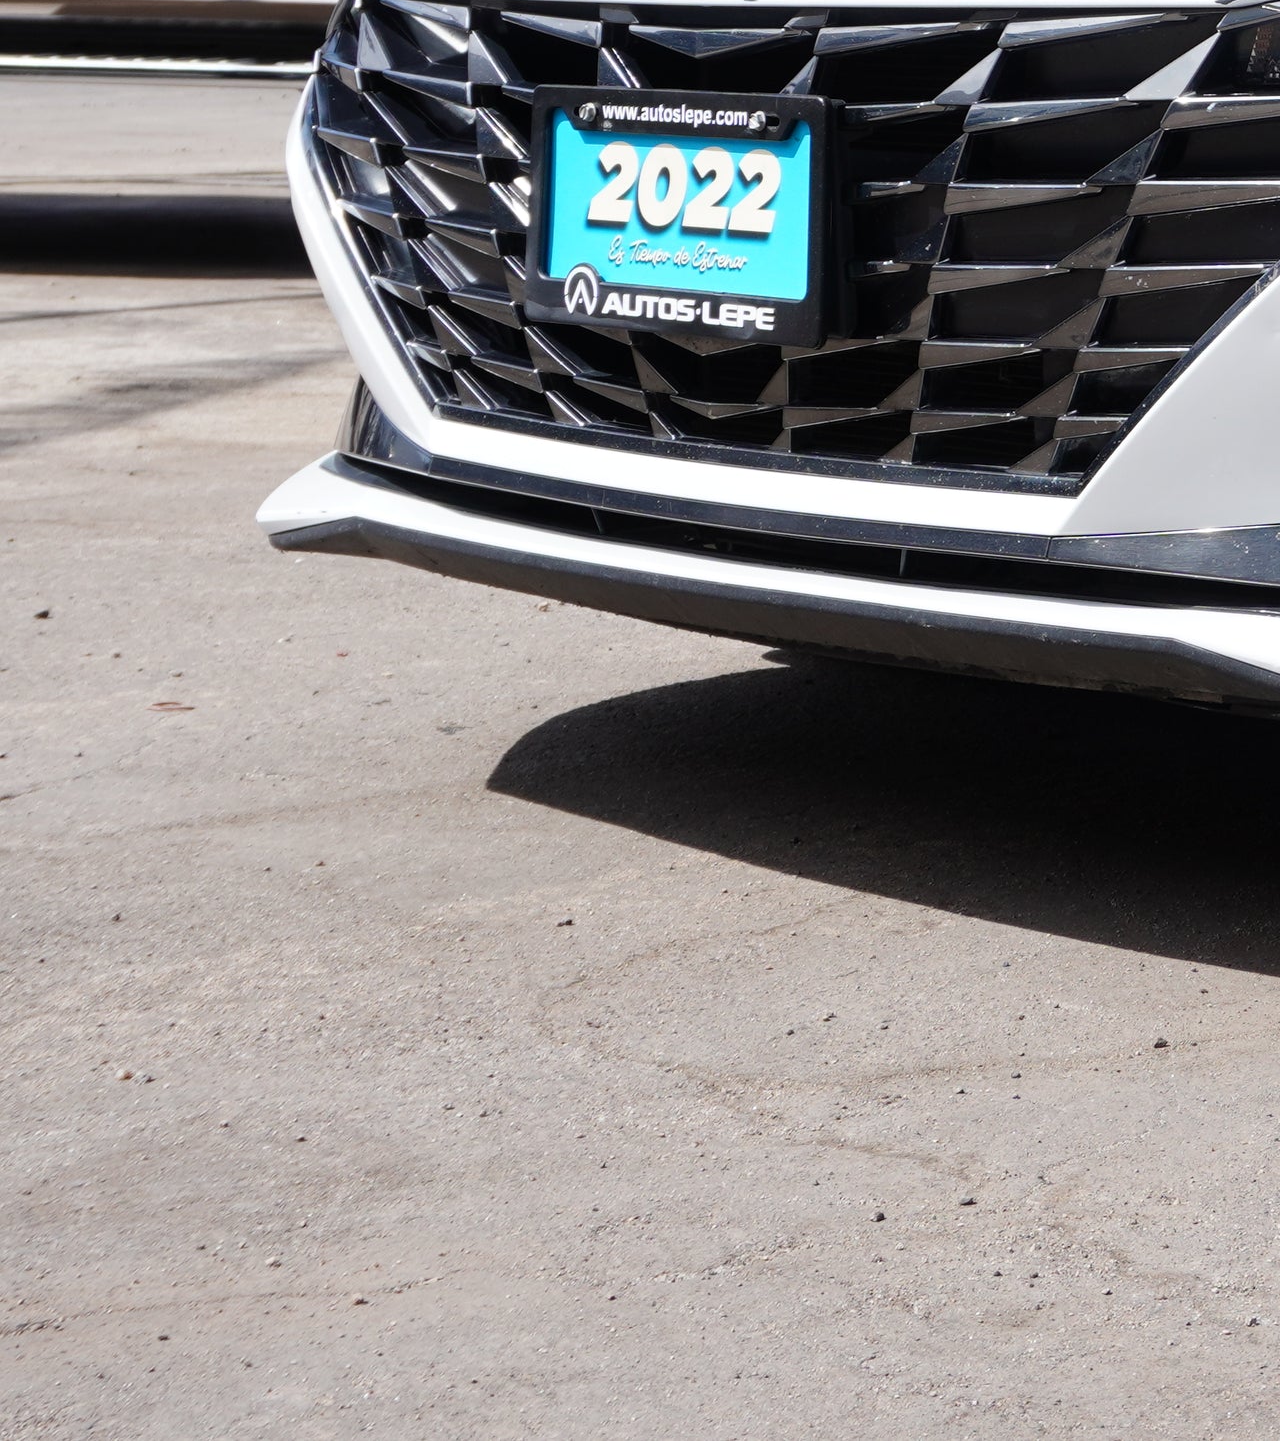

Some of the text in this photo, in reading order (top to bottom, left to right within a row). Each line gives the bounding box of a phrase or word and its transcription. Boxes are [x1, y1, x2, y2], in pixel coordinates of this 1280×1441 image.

[602, 104, 748, 127] www.autoslepe.com
[587, 141, 781, 233] 2022
[608, 234, 749, 274] Es Tiempo de Estrenar
